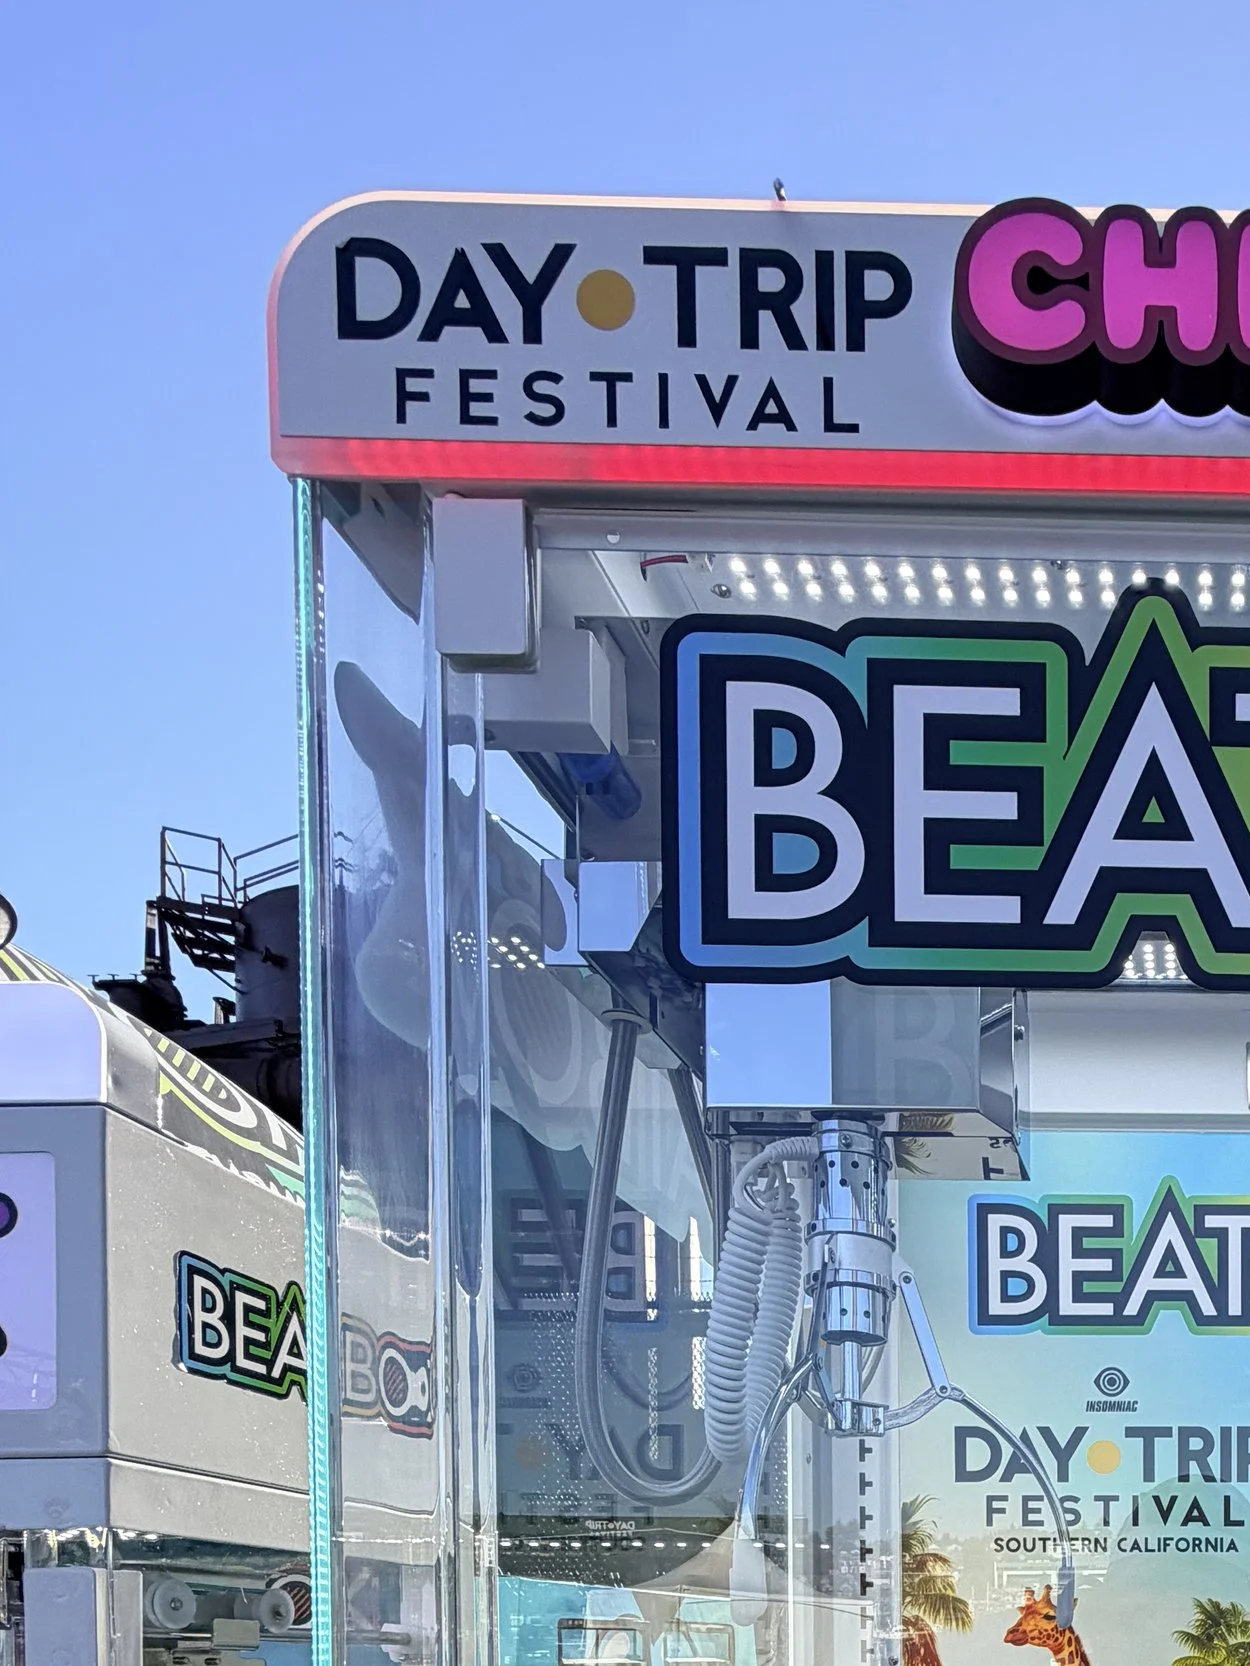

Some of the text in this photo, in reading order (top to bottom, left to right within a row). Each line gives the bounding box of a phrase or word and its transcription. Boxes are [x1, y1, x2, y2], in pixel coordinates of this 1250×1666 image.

[336, 236, 912, 353] DAY TRIP
[394, 367, 860, 434] FESTIVAL
[1085, 1400, 1139, 1413] INSOMNIAC
[954, 1425, 1090, 1484] DAY
[985, 1494, 1245, 1528] FESTIVAL
[993, 1536, 1240, 1554] SOUTHERN CALIFORNIA
